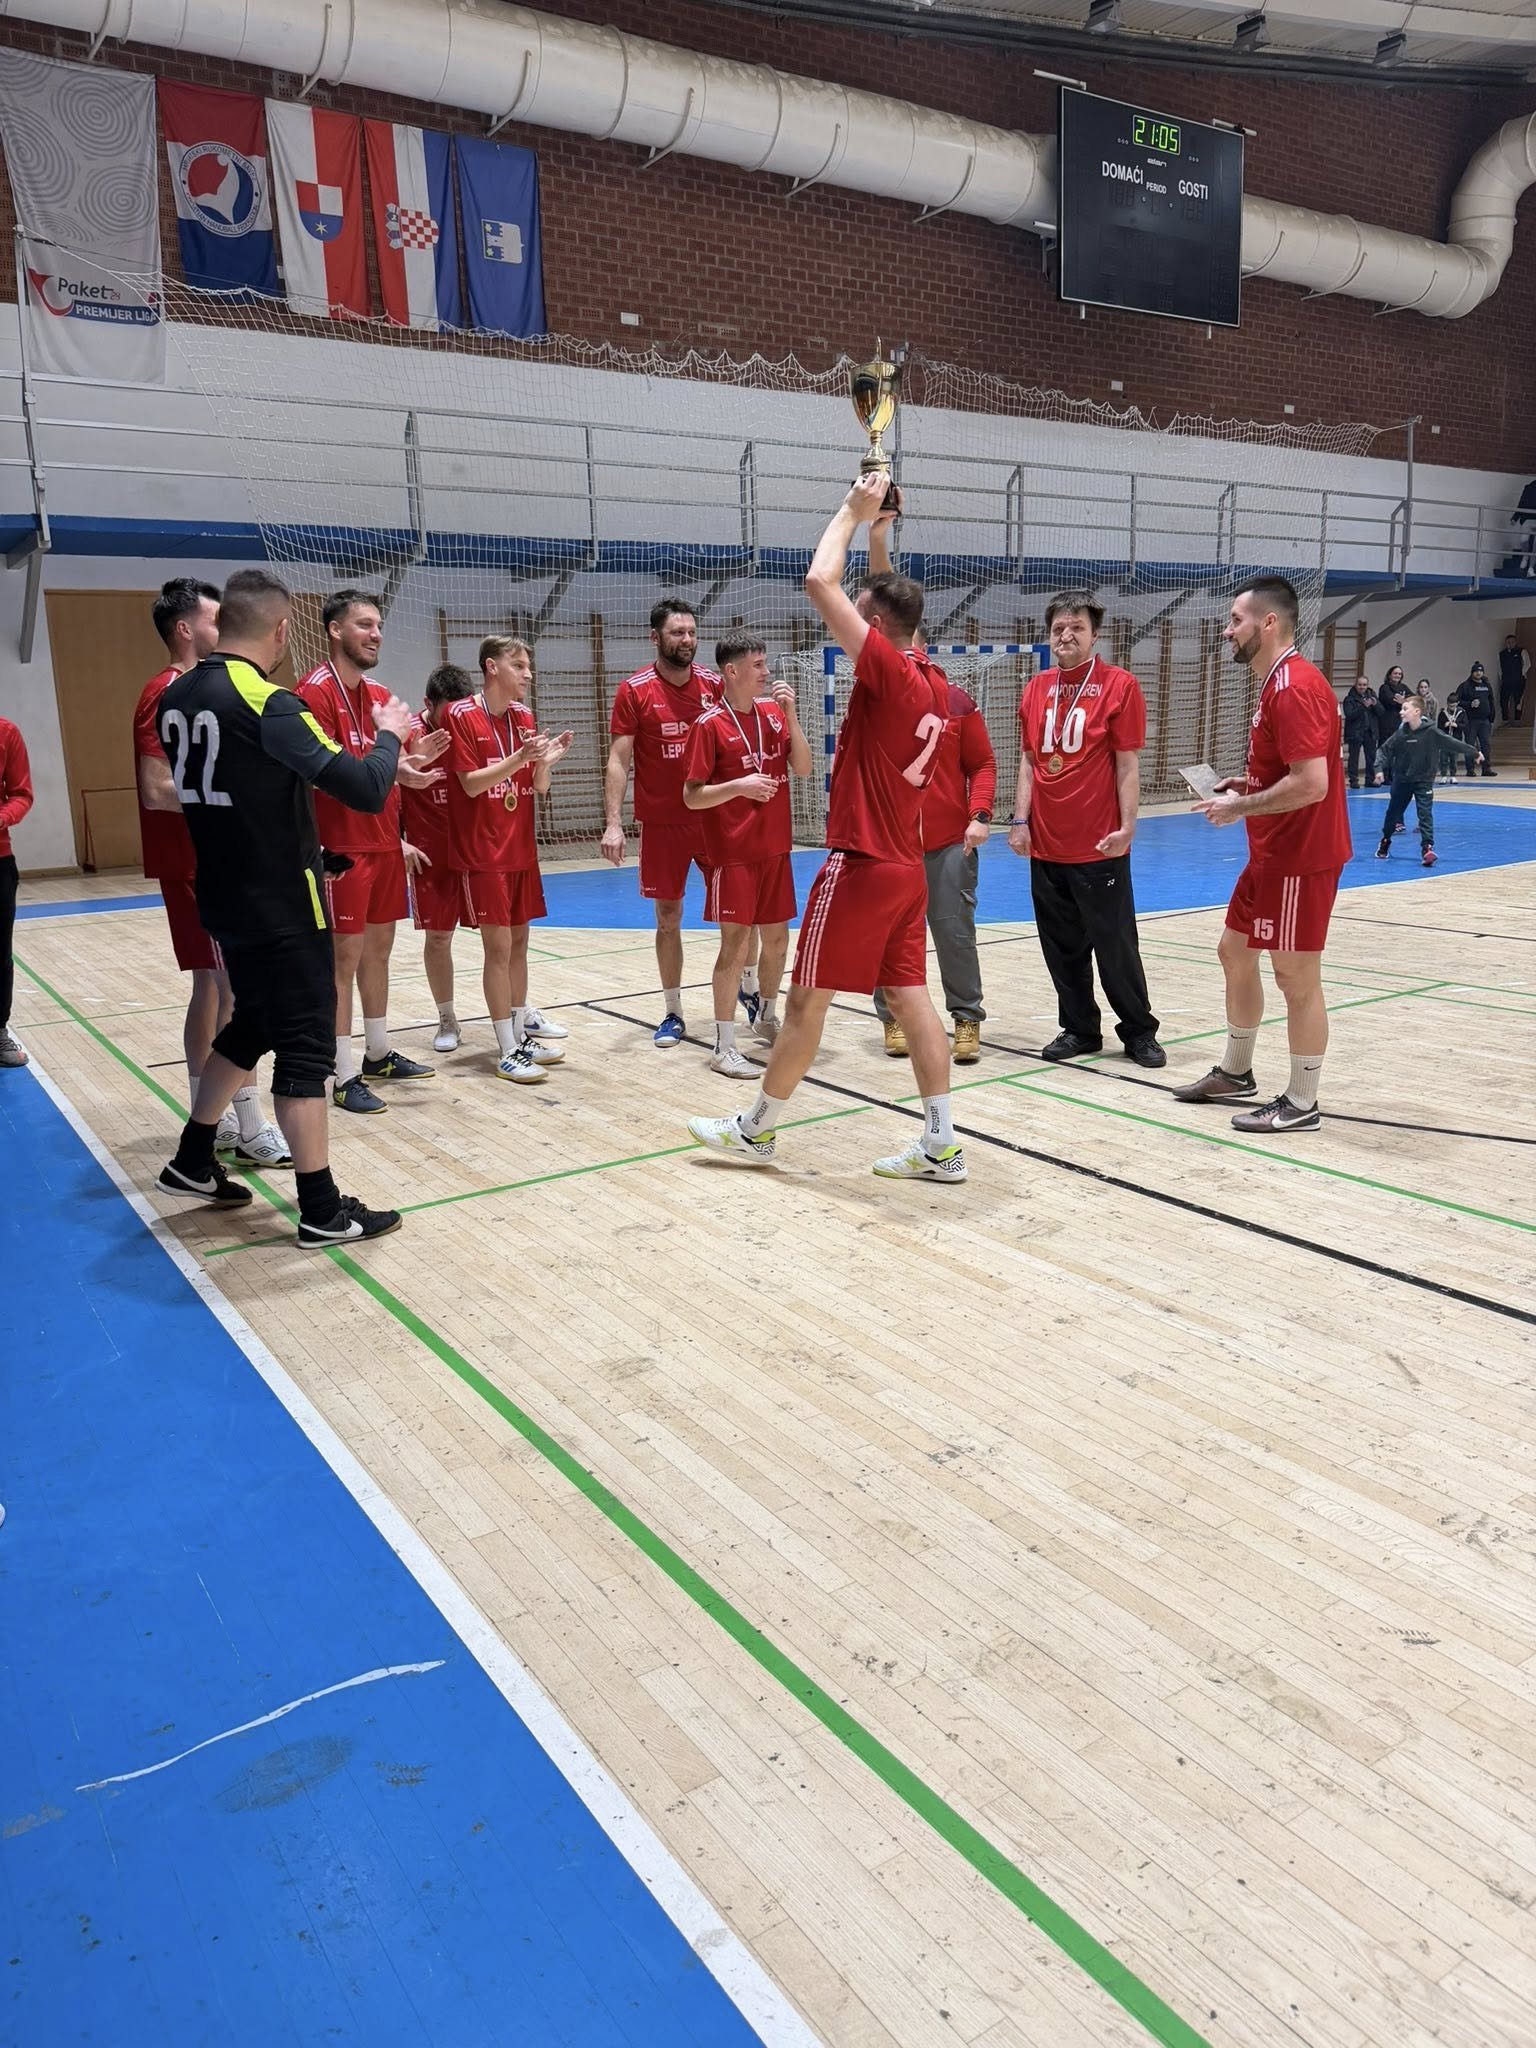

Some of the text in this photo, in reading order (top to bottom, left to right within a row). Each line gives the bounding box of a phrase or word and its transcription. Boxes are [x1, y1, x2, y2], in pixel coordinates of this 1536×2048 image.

[1135, 119, 1178, 151] 21:05
[1102, 161, 1144, 185] DOMAĆI
[1146, 181, 1167, 194] PERIOD
[1178, 179, 1208, 200] GOSTI
[76, 304, 133, 320] PREMIJER
[1041, 707, 1086, 753] 10
[162, 709, 233, 806] 22
[902, 712, 949, 787] 2
[488, 781, 519, 799] LEPN
[1253, 917, 1274, 940] 15
